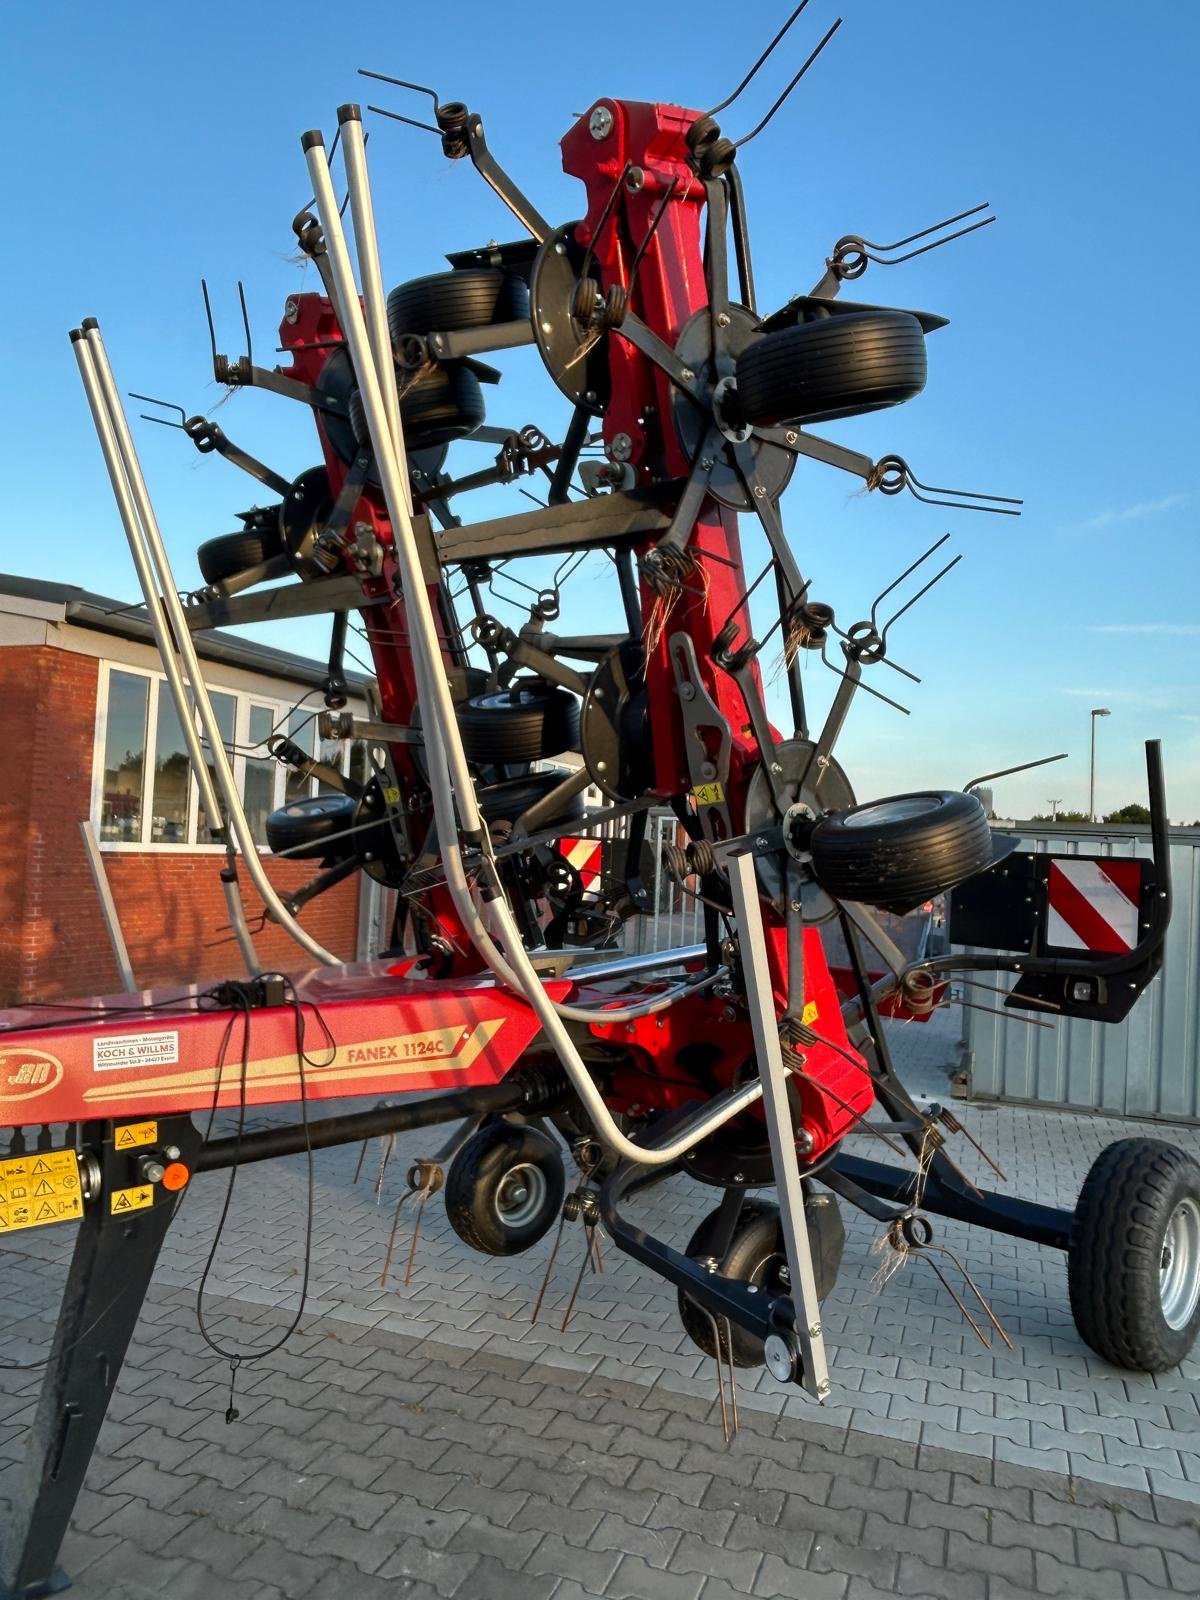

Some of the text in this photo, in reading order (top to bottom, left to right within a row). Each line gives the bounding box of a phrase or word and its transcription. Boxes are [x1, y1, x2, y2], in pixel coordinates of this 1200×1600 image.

[97, 1043, 175, 1059] KOCH & WILLMS
[347, 1040, 444, 1063] FANEX 1124C
